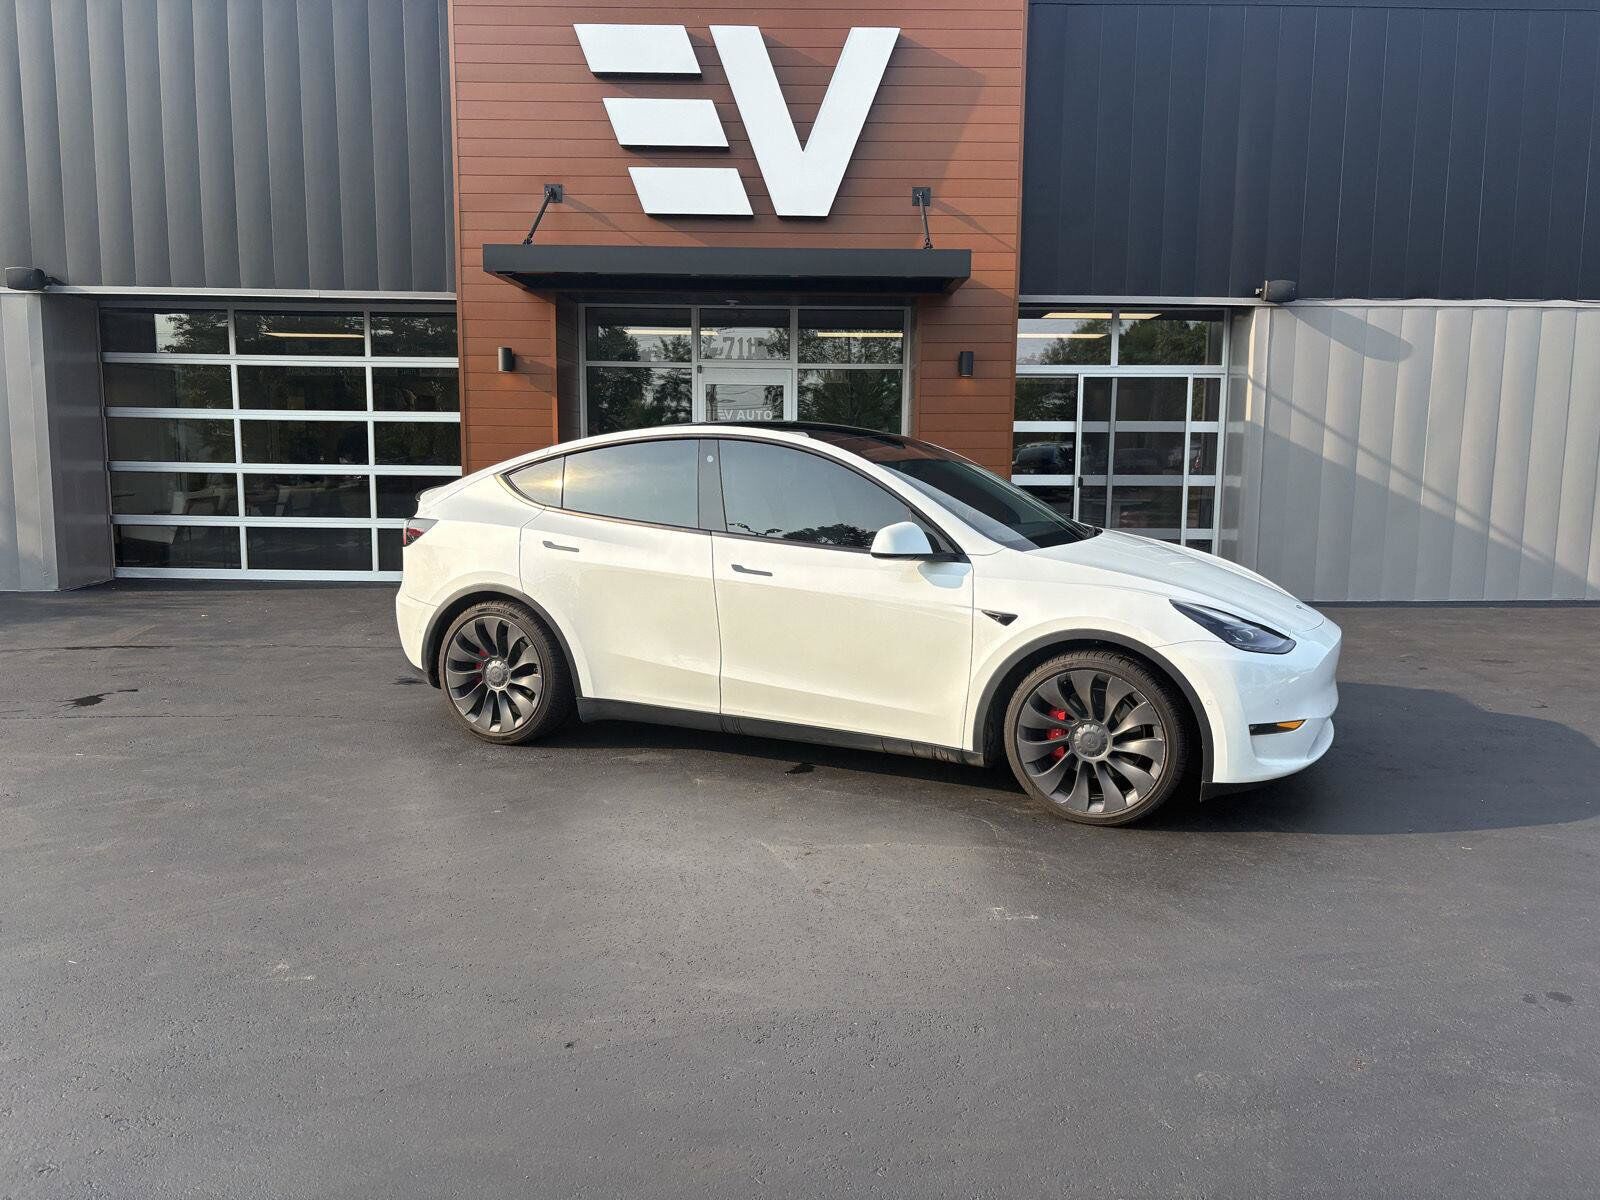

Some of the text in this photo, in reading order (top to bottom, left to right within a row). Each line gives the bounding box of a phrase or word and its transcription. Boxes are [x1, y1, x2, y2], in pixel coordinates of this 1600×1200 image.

[573, 24, 901, 217] EV
[718, 409, 773, 420] EV AUTO
